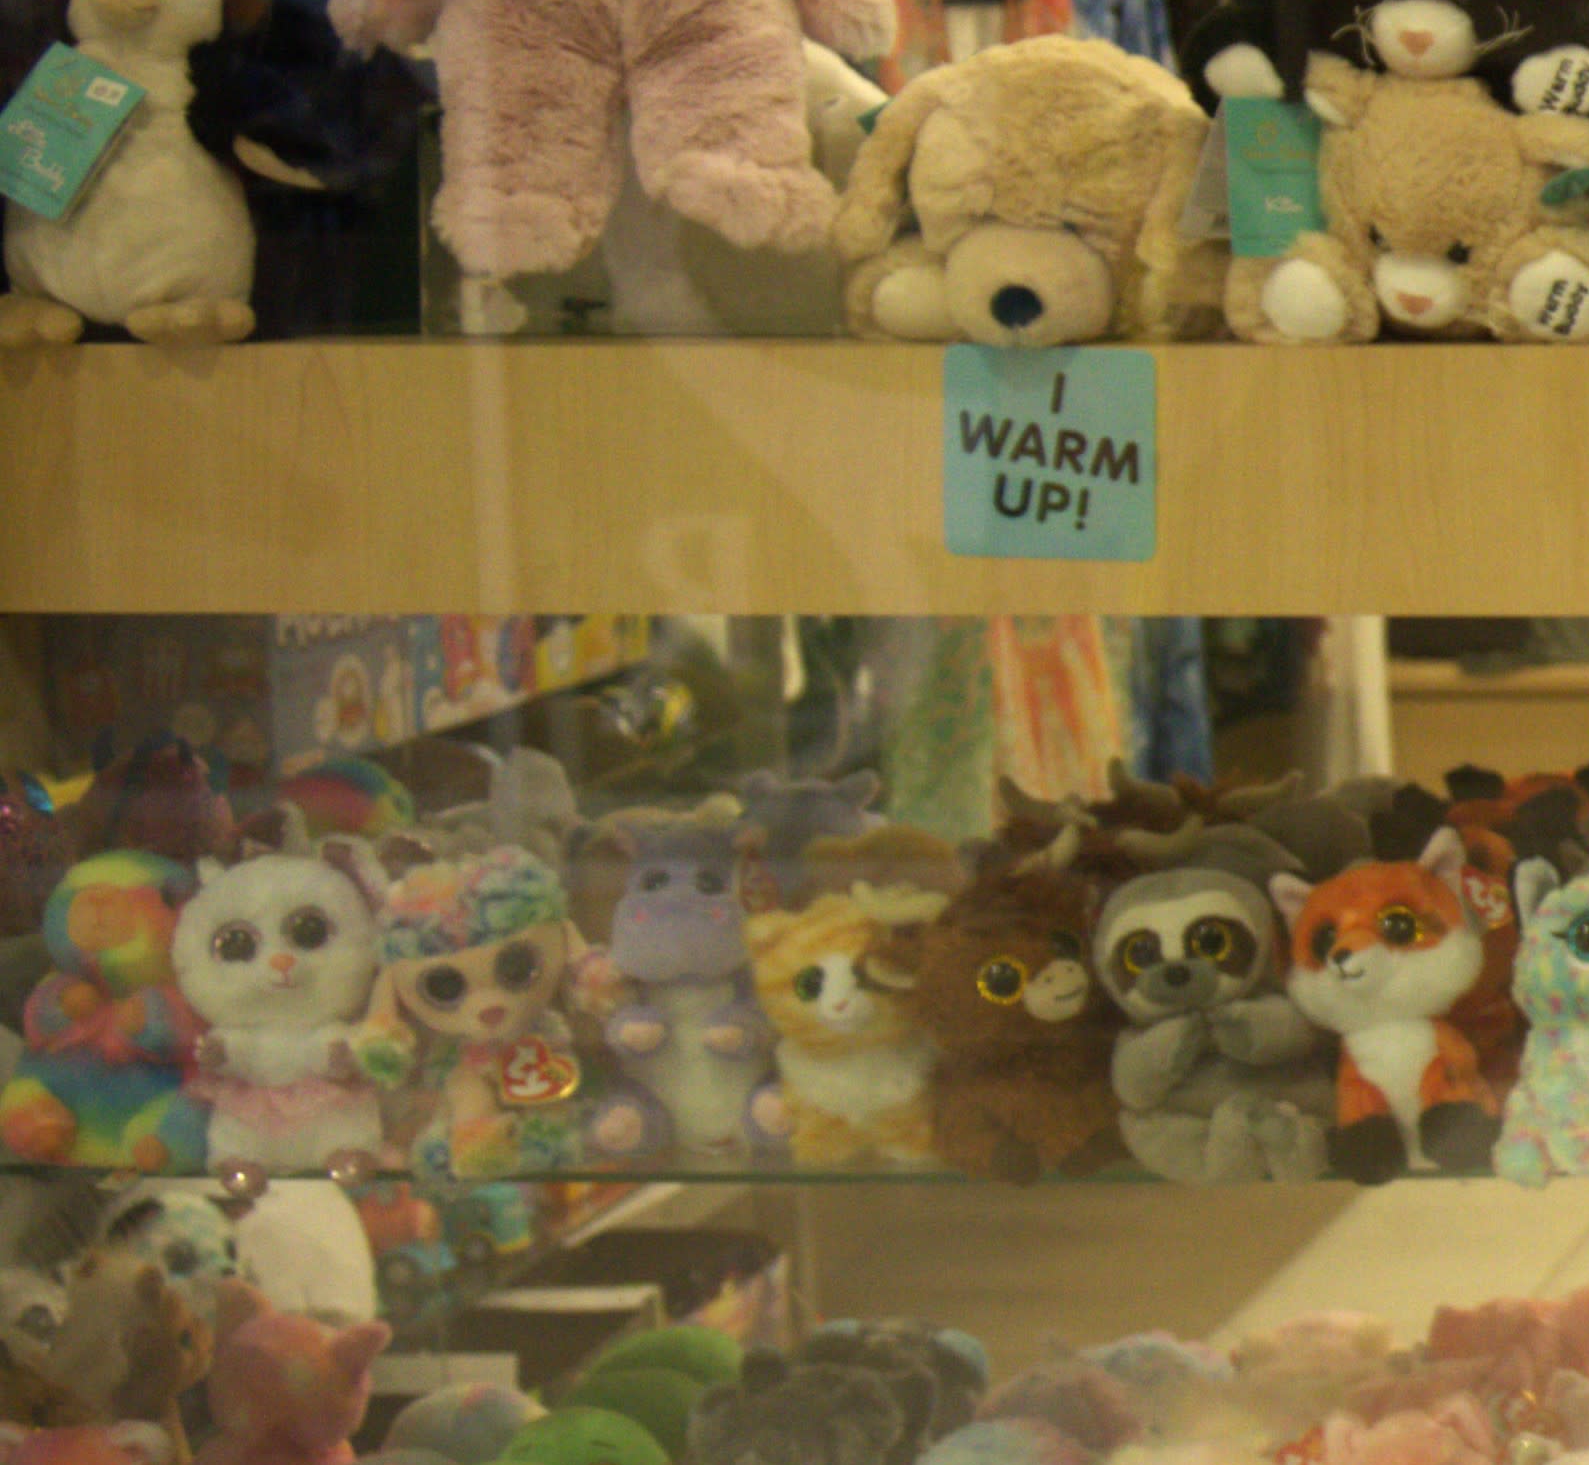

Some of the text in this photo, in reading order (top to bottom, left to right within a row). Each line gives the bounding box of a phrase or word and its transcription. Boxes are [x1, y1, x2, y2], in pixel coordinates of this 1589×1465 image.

[1050, 371, 1066, 414] I
[959, 408, 1140, 485] WARM
[992, 471, 1091, 531] UP!
